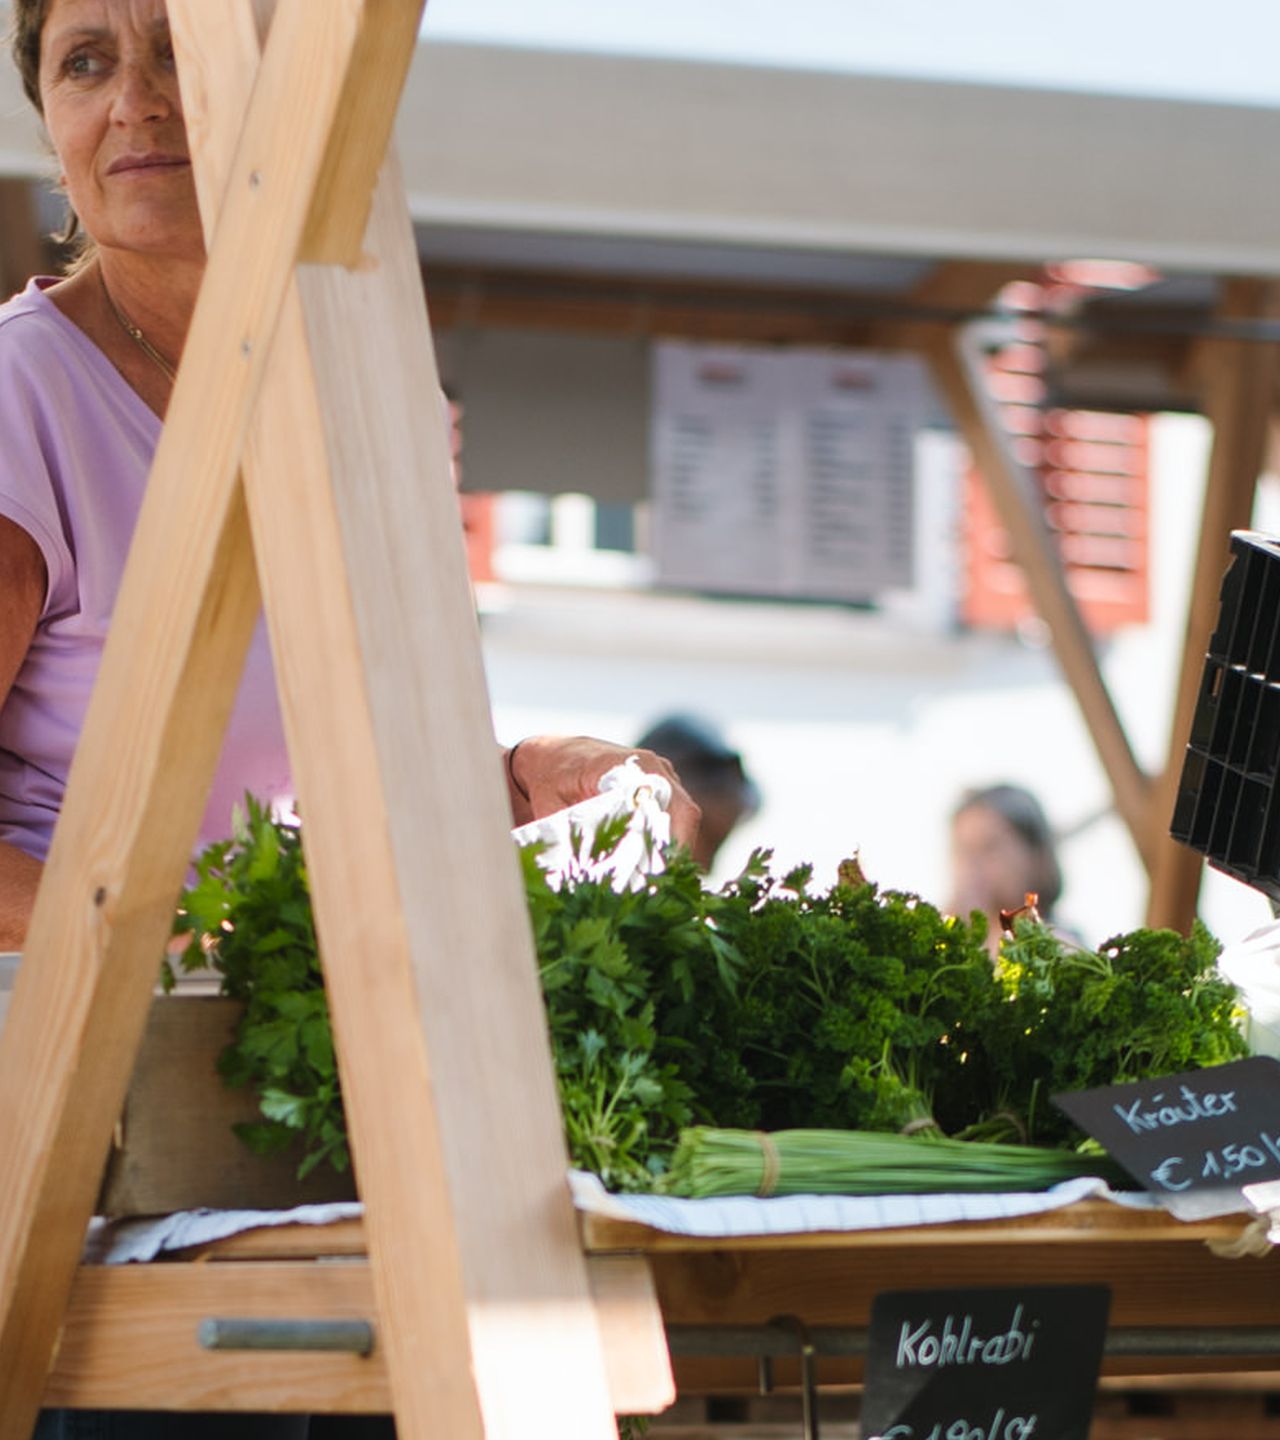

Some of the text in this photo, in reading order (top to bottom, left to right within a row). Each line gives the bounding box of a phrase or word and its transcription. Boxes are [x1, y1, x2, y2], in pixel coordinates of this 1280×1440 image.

[1113, 1084, 1238, 1135] Kräuter
[1150, 1156, 1193, 1192] €
[895, 1303, 1042, 1370] Kohlrabi
